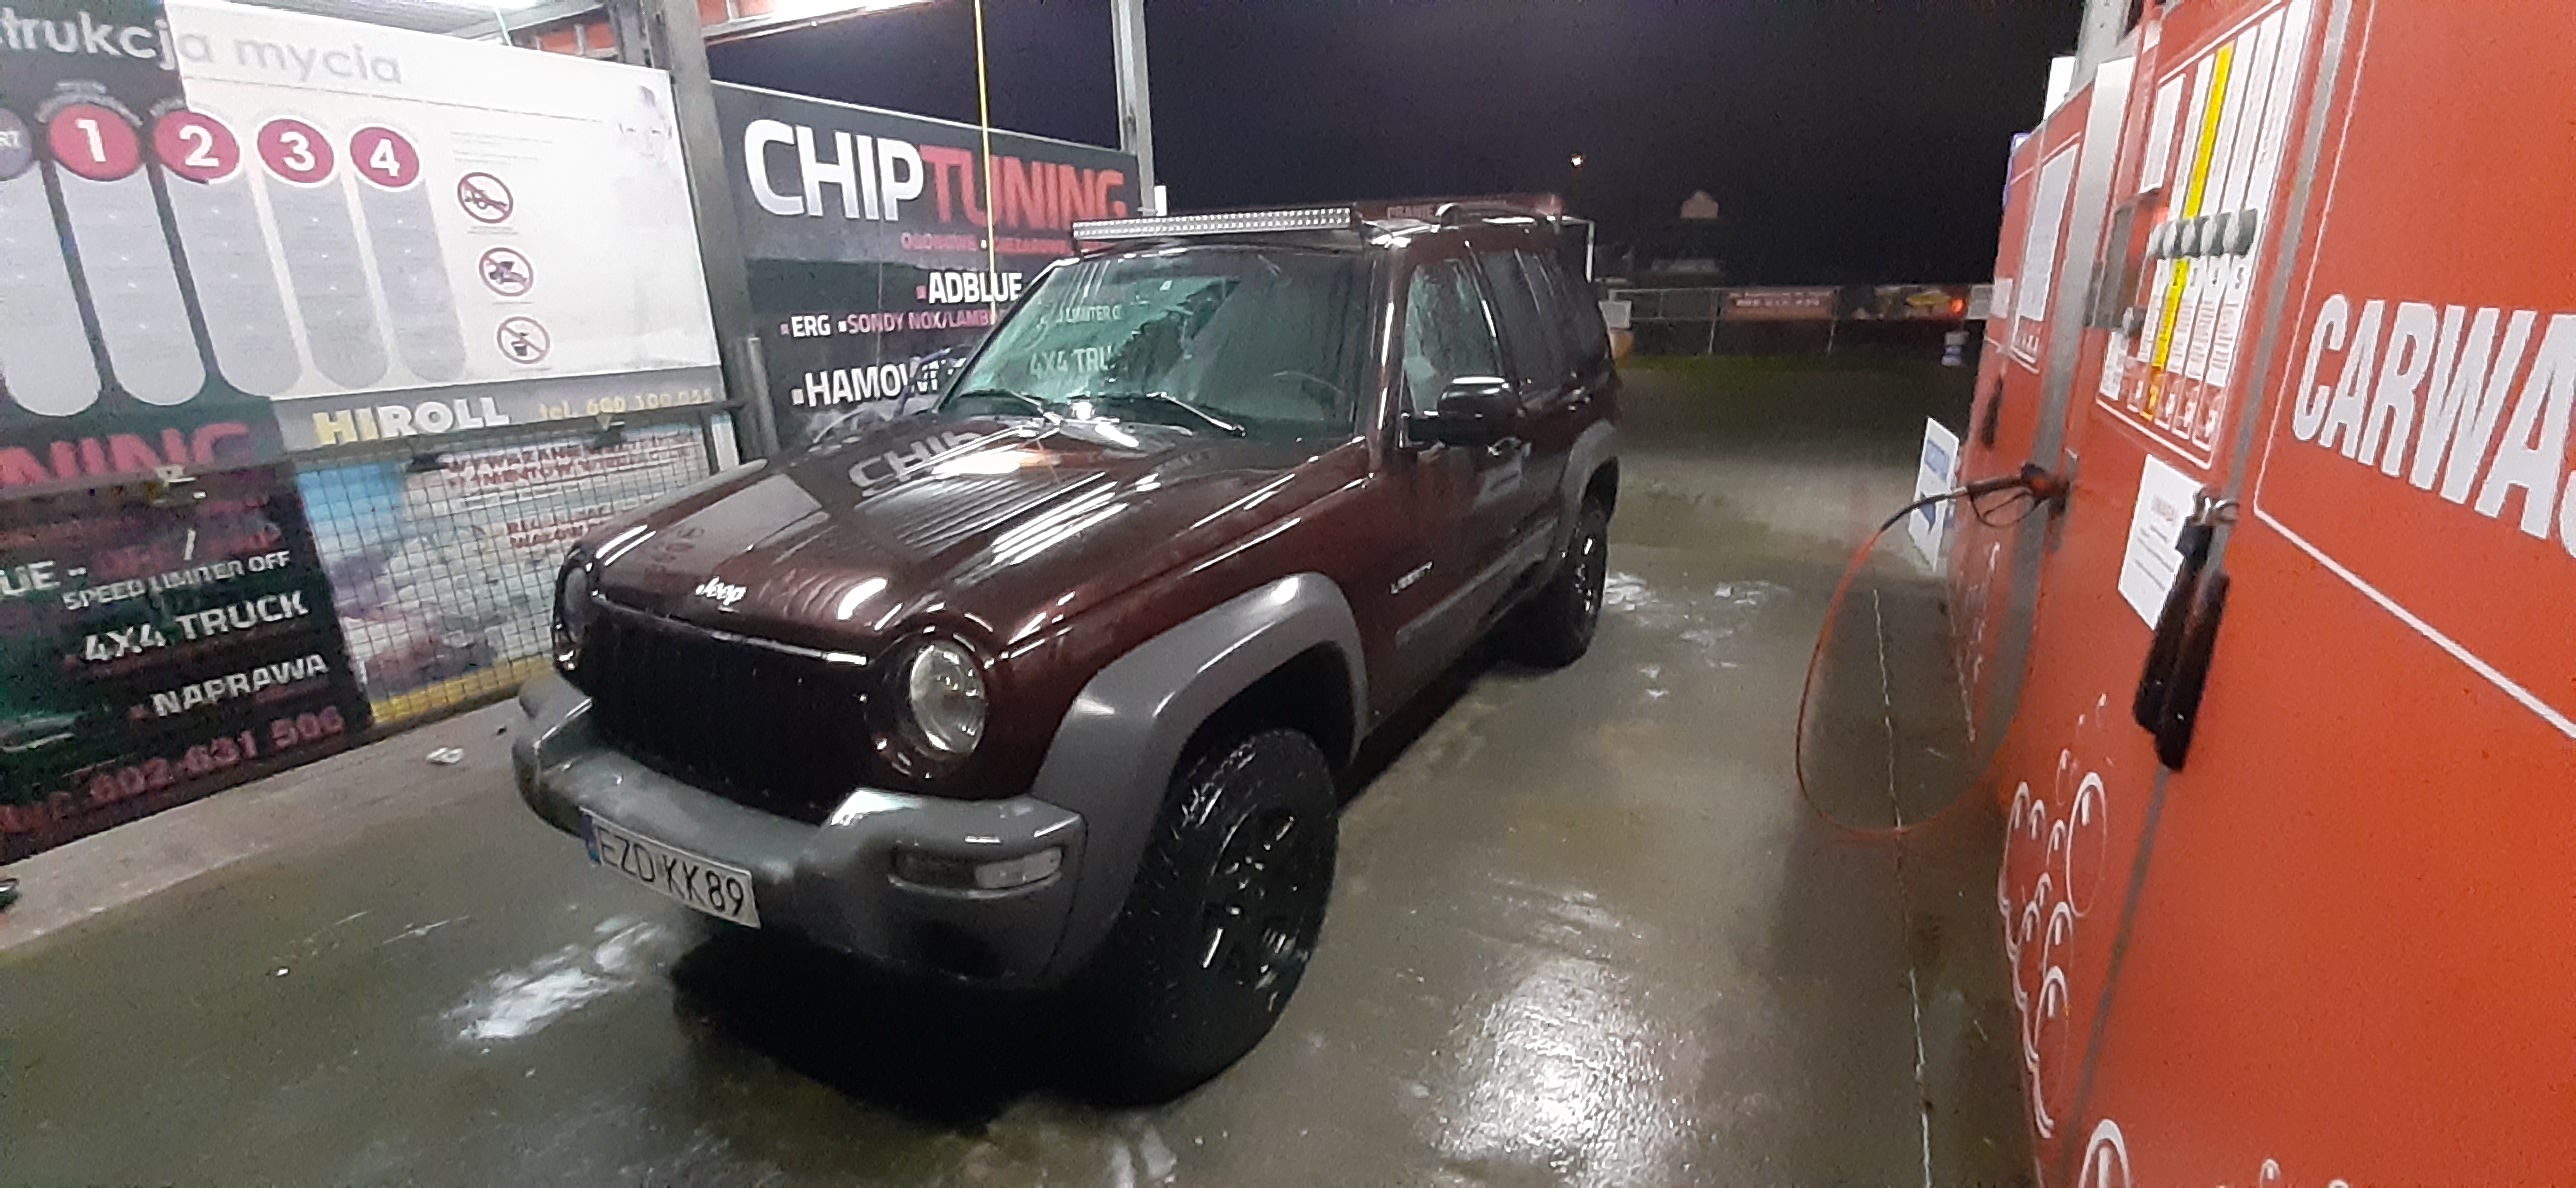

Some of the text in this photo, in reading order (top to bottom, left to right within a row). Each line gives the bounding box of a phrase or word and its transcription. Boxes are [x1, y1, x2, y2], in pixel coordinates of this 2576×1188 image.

[0, 7, 402, 82] trukcja mycia
[76, 118, 400, 176] 1 2 3 4
[929, 271, 1023, 304] ADBLUE
[791, 309, 996, 338] ERG SONDY NOX/LAMB
[312, 395, 510, 446] HIROLL
[62, 579, 146, 611] SPEED
[248, 551, 290, 573] OFF
[85, 590, 309, 662] 4X4 TRUCK
[151, 653, 331, 718] NAPRAWA
[662, 854, 745, 917] KK89
